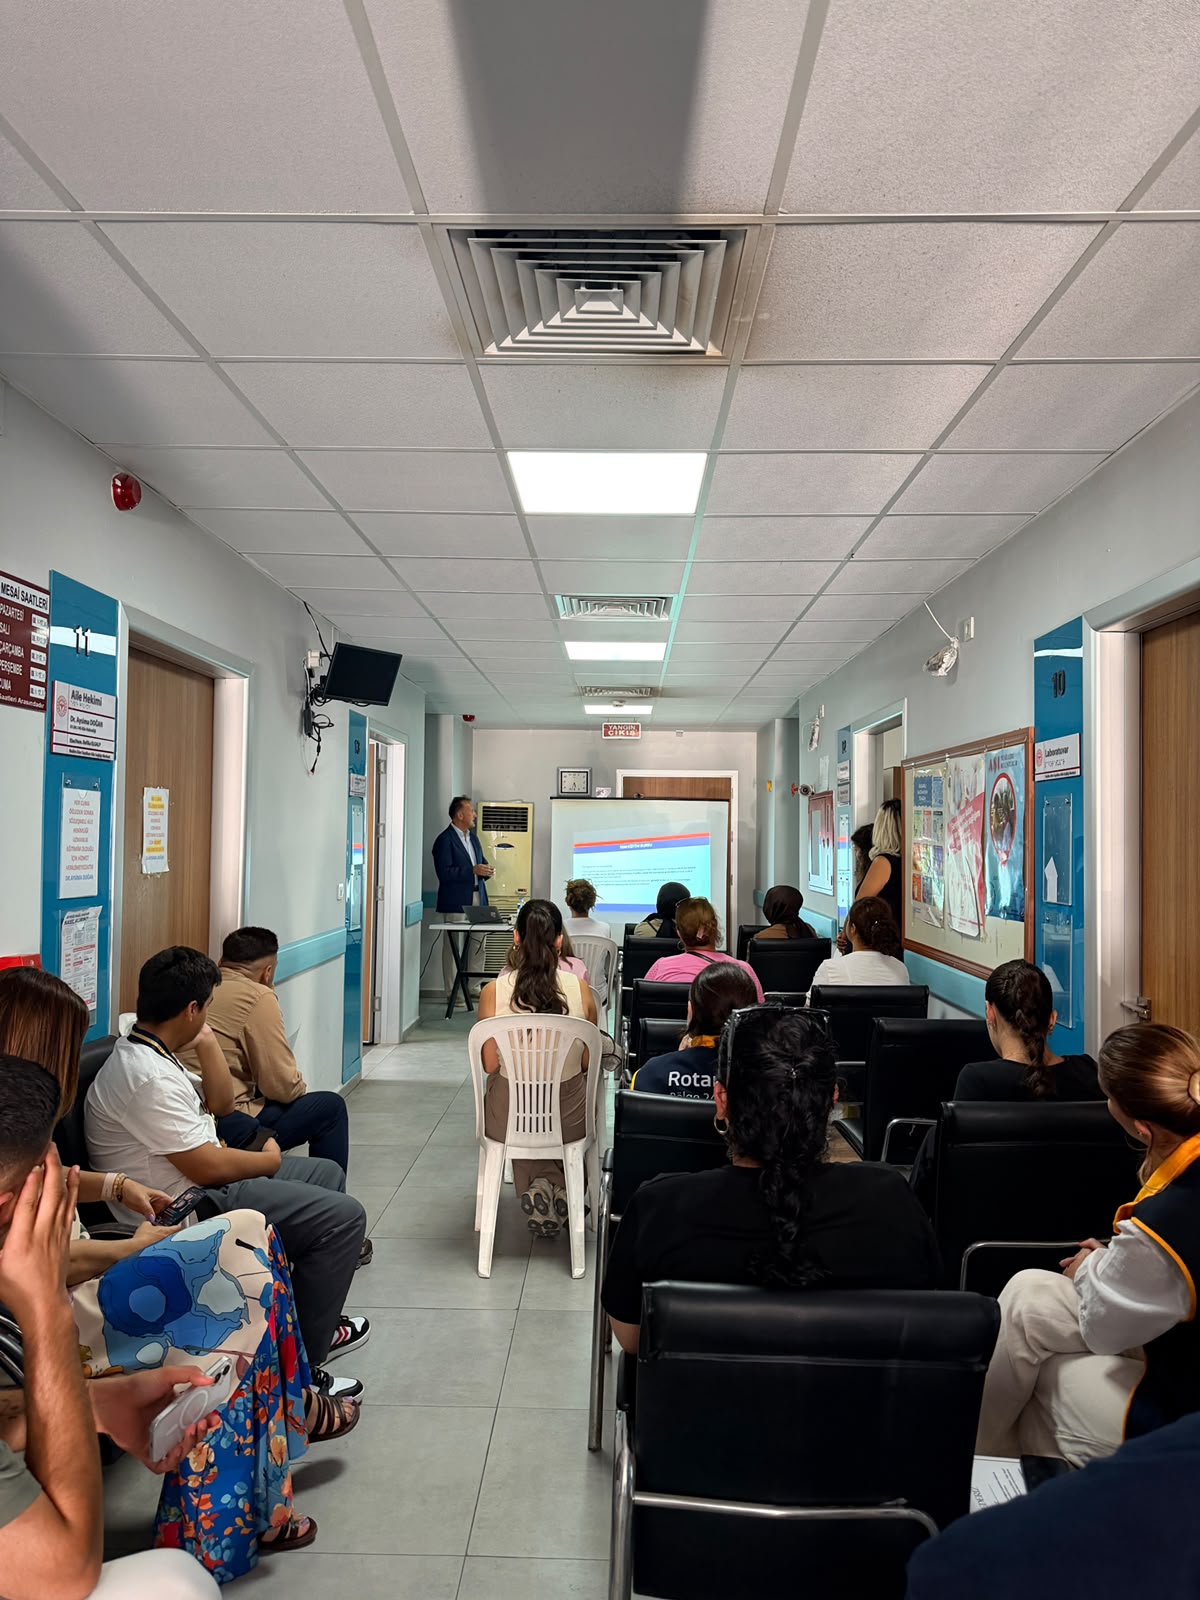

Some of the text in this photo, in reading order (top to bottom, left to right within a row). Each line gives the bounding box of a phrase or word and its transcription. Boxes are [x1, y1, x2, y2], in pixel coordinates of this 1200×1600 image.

[1, 582, 48, 610] MESAİ SAATLERİ
[74, 625, 90, 657] 11
[71, 690, 102, 706] Aile Hekimi
[1052, 670, 1066, 698] 10
